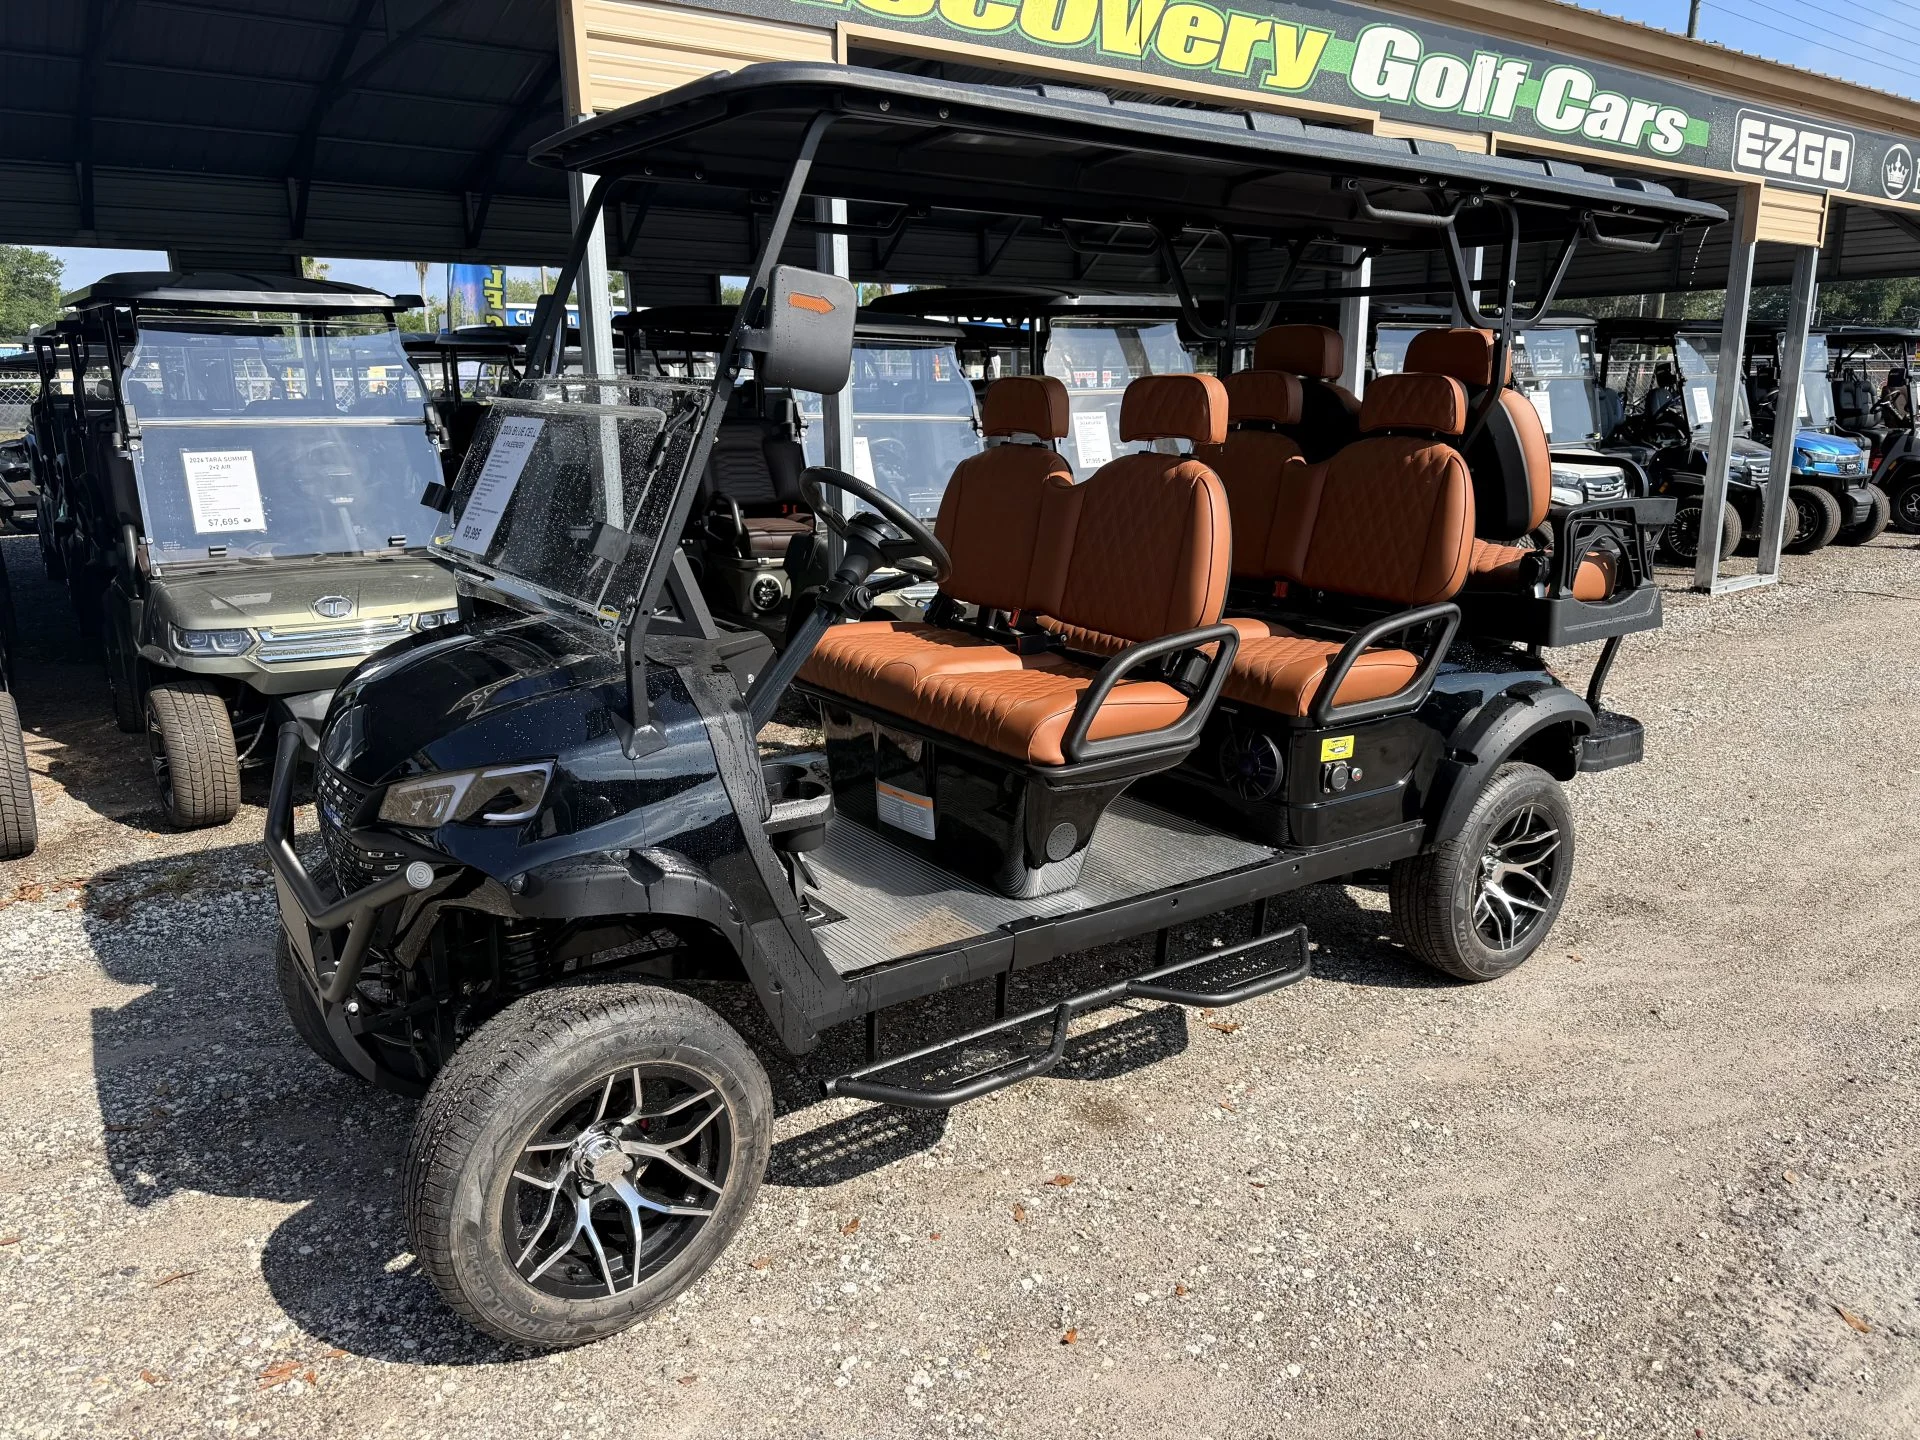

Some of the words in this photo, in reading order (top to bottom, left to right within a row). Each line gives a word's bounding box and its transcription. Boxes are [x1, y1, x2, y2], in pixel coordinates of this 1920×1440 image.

[1351, 25, 1525, 119] Golf
[1535, 65, 1688, 152] Cars
[208, 517, 239, 527] $7,695
